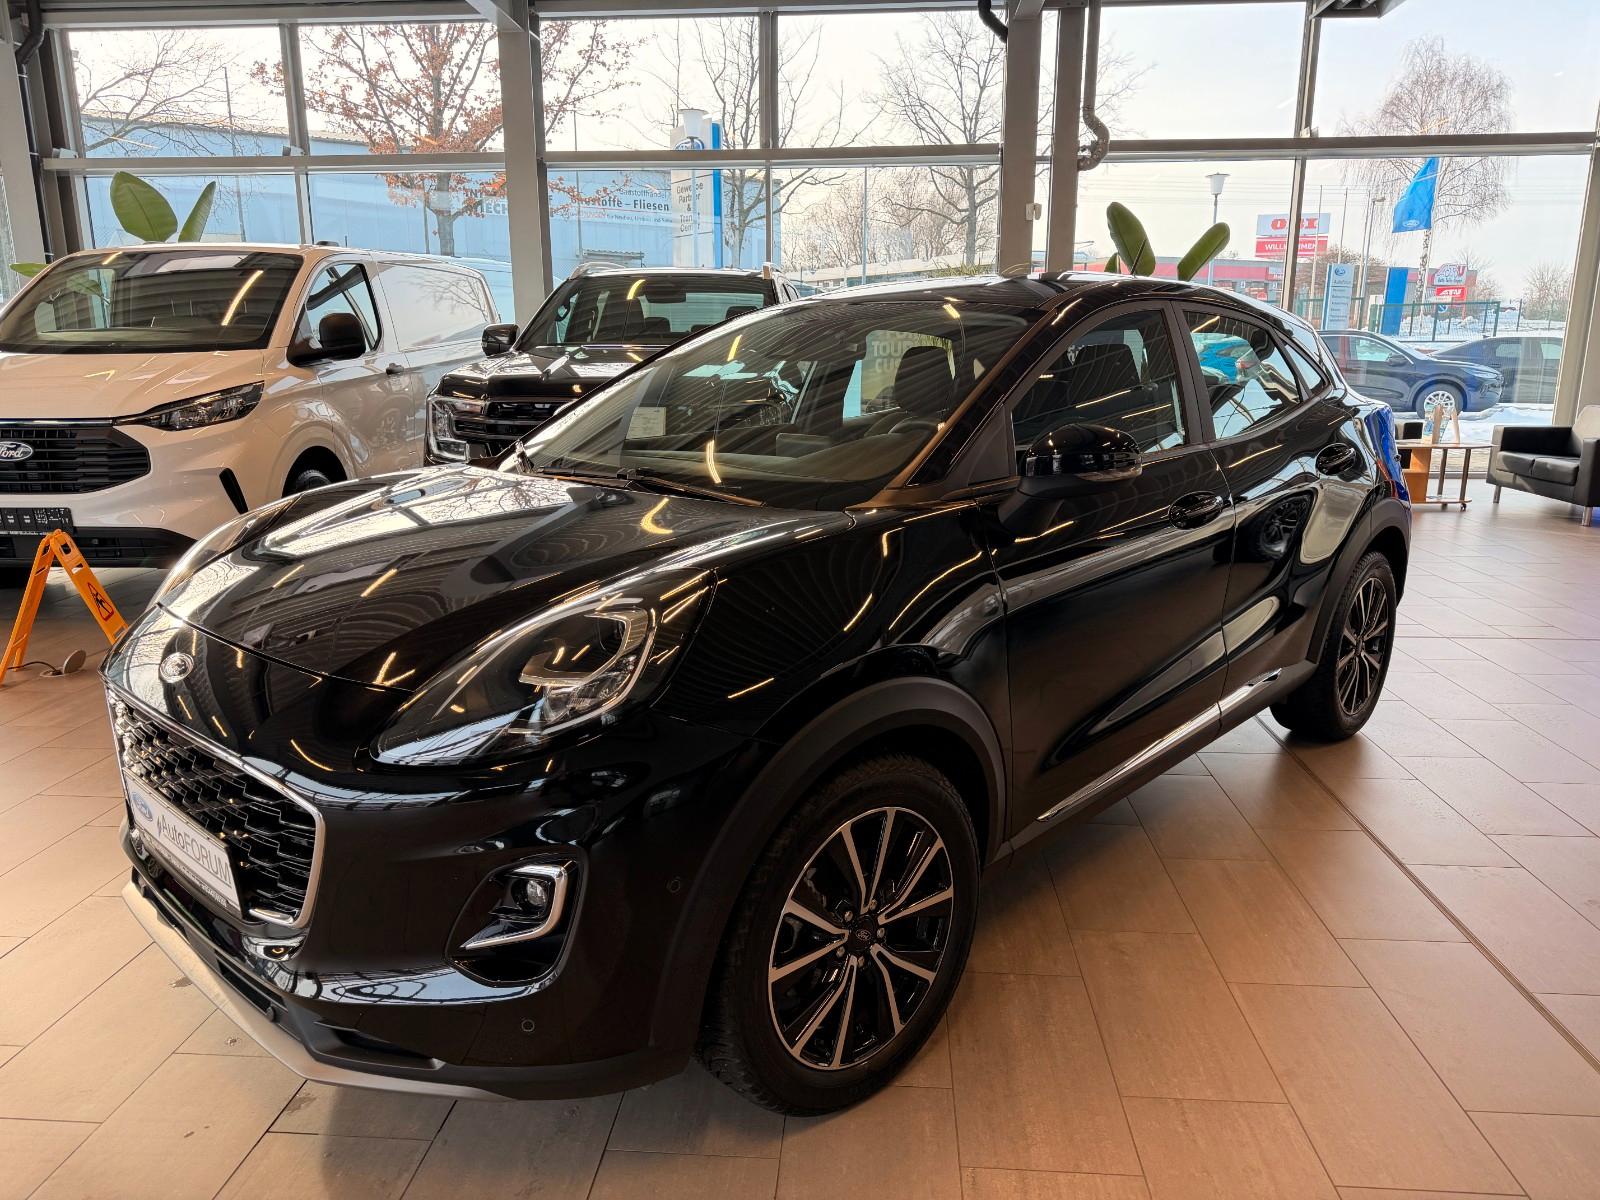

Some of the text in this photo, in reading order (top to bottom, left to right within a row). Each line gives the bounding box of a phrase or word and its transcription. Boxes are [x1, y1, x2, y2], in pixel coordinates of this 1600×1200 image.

[676, 182, 704, 194] Gewebe
[678, 193, 701, 204] Partr
[633, 199, 670, 212] Fliesen
[161, 814, 232, 885] AutoFORUM
